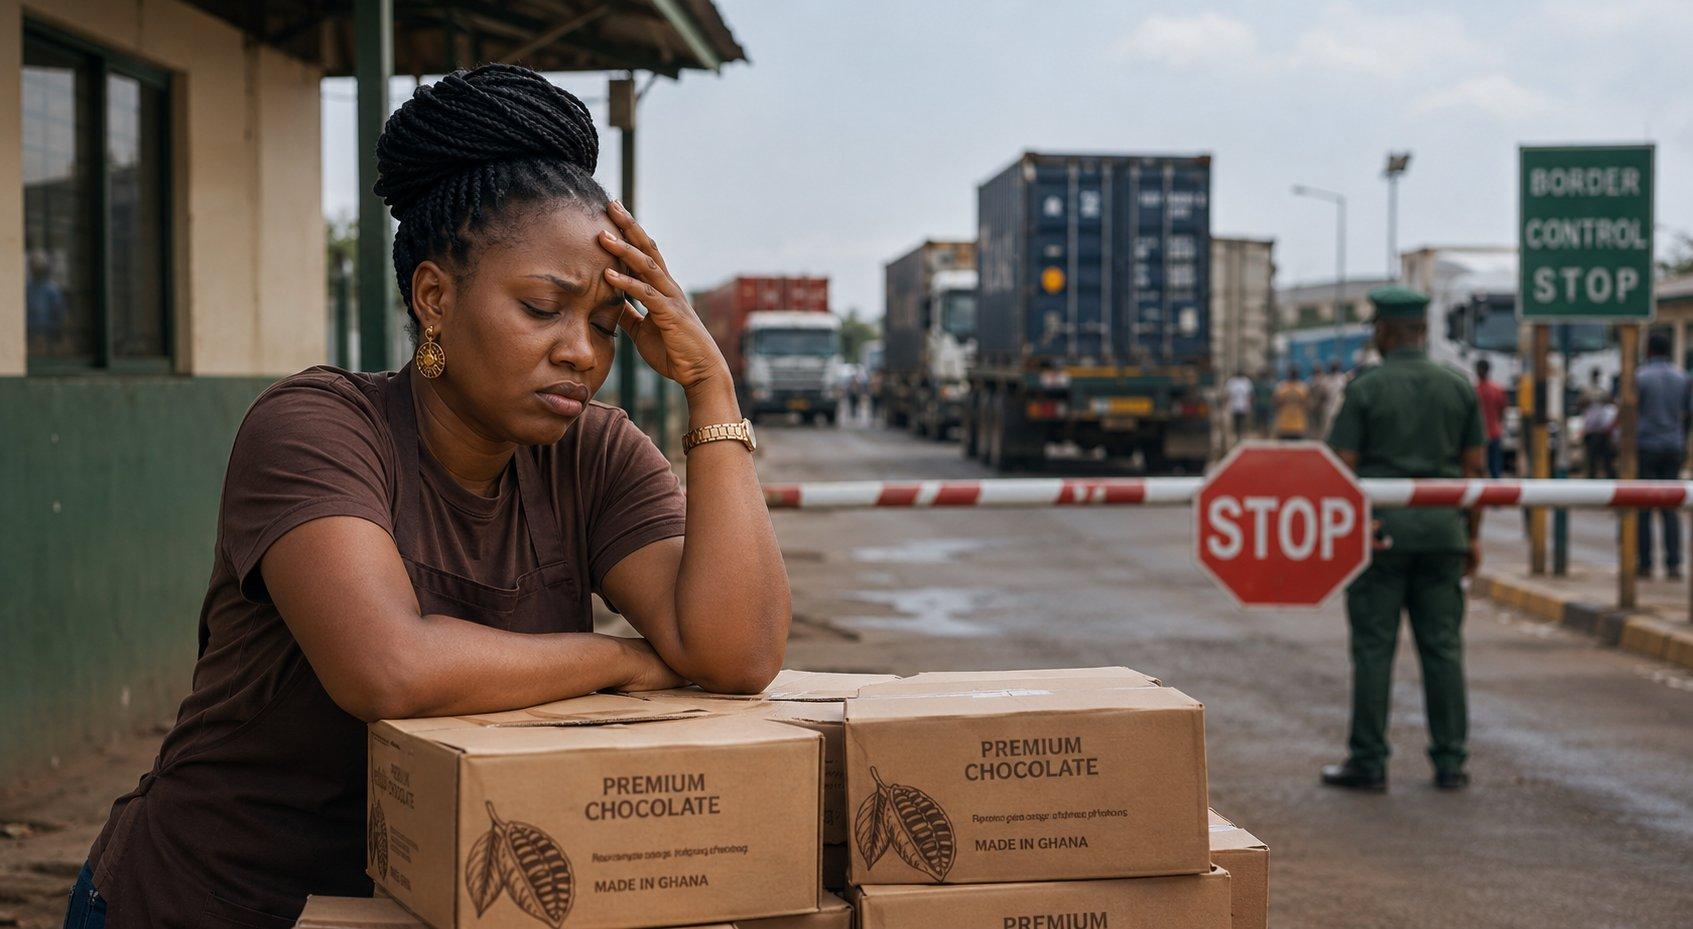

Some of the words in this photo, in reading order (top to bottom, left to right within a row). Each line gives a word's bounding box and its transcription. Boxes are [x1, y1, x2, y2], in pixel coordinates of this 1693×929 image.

[1530, 167, 1640, 197] BORDER
[1525, 217, 1648, 249] CONTROL
[1533, 266, 1639, 304] STOP
[1207, 495, 1356, 561] STOP
[981, 736, 1082, 758] PREMIUM
[965, 758, 1099, 781] CHOCOLATE
[603, 773, 705, 796] PREMIUM
[585, 796, 721, 821] CHOCOLATE
[975, 839, 1016, 851] MADE
[1020, 838, 1034, 850] IN
[1038, 836, 1088, 849] GHANA
[595, 879, 636, 893] MADE
[640, 877, 655, 890] IN
[659, 875, 709, 888] GHANA
